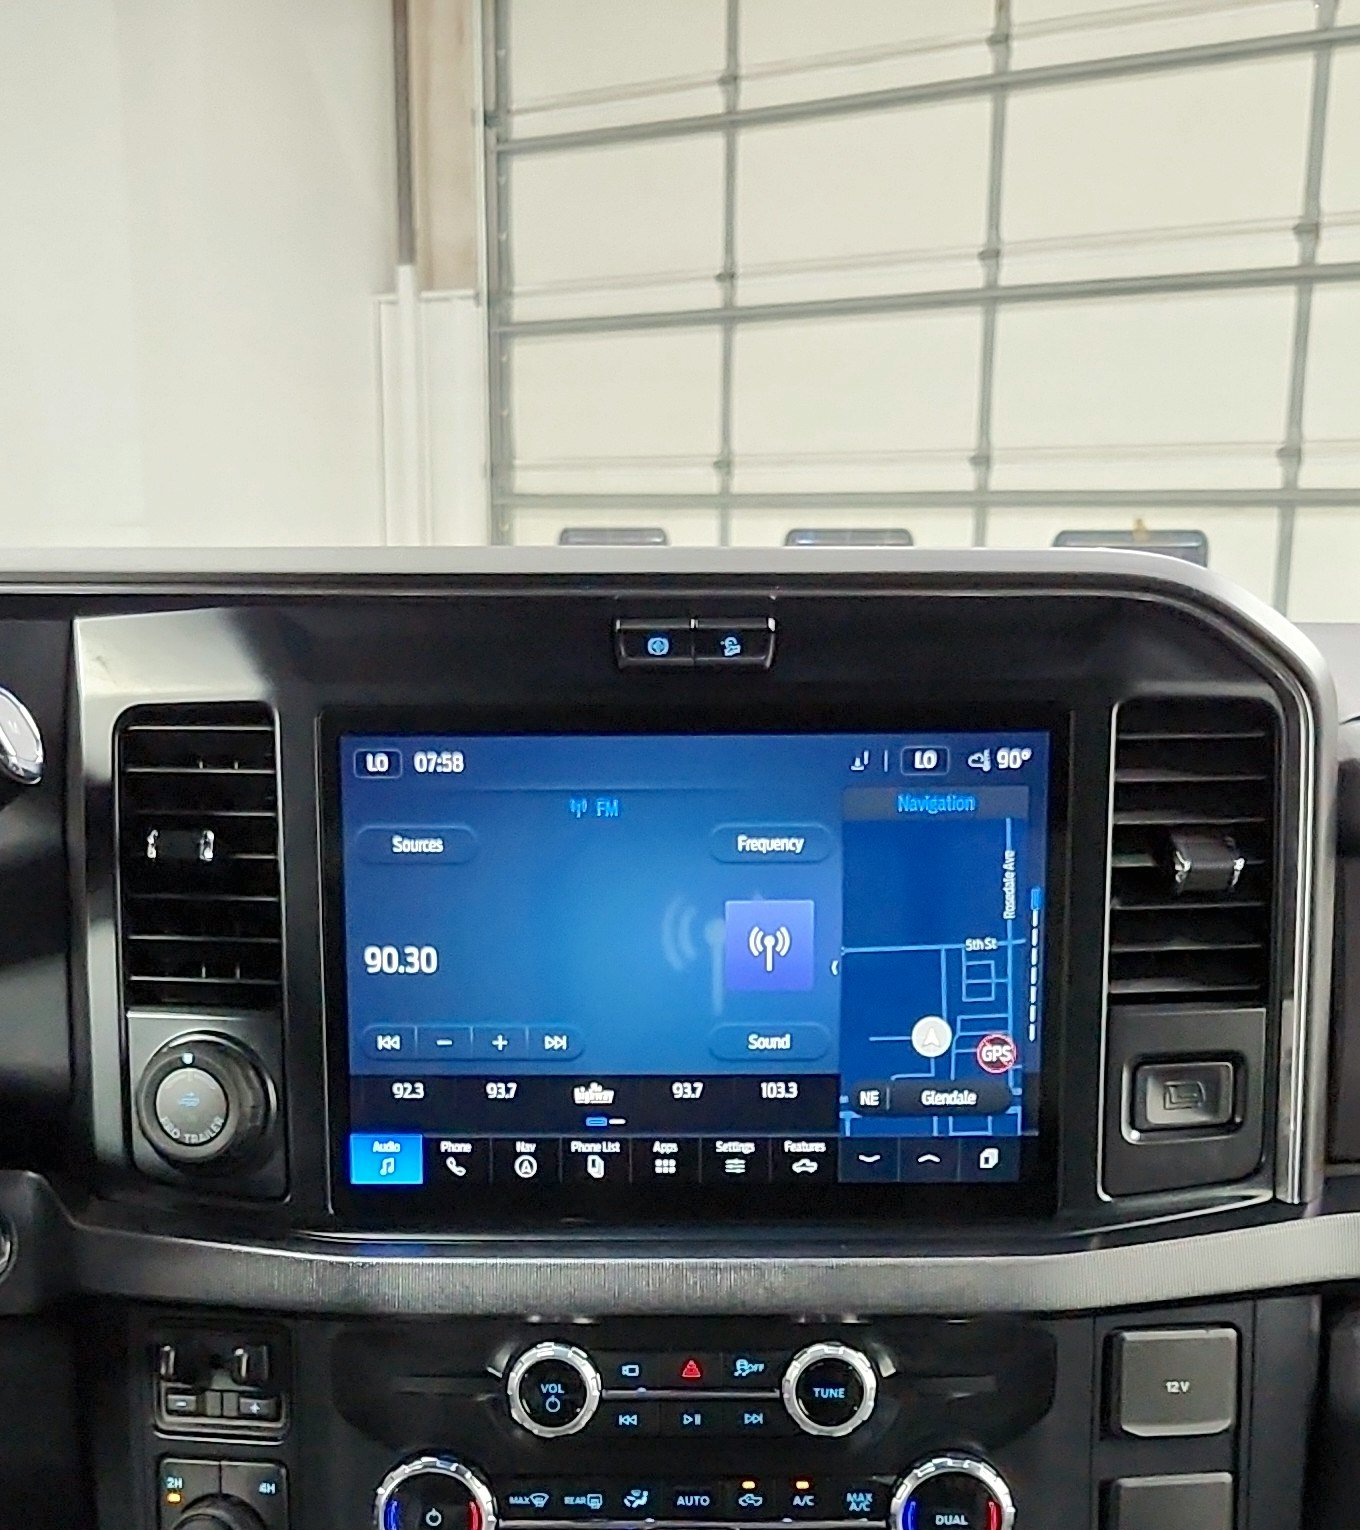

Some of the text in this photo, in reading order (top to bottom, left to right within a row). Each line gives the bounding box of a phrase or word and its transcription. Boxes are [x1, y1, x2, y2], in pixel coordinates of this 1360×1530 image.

[366, 753, 389, 773] LO
[414, 751, 465, 773] 07:58
[914, 750, 938, 770] LO
[996, 747, 1033, 770] 90°
[597, 799, 619, 817] FM
[897, 795, 976, 814] Navigation
[392, 834, 443, 853] Sources
[737, 834, 805, 854] Frequency
[1002, 872, 1016, 919] Rosedale
[965, 938, 983, 952] 5th
[364, 945, 439, 975] 90.30
[747, 1033, 791, 1050] Sound
[981, 1044, 1012, 1062] GPS
[392, 1081, 424, 1099] 92.3
[486, 1081, 517, 1099] 93.7
[671, 1082, 704, 1099] 93.7
[760, 1082, 798, 1099] 103.3
[921, 1089, 978, 1106] Glendale
[859, 1090, 880, 1106] NE
[372, 1140, 401, 1153] Audio
[440, 1140, 472, 1153] Phone
[515, 1140, 537, 1153] Nav
[570, 1140, 621, 1153] Phone List
[652, 1140, 678, 1154] Apps
[715, 1140, 756, 1155] Settings
[783, 1140, 827, 1153] Features
[540, 1383, 565, 1394] VOL
[812, 1387, 846, 1399] TUNE
[166, 1477, 183, 1489] 2H
[258, 1482, 276, 1495] 4H
[509, 1496, 531, 1505] MAX
[564, 1496, 587, 1505] REAR
[676, 1495, 711, 1507] AUTO
[792, 1495, 815, 1507] A/C
[846, 1492, 873, 1502] MAX
[848, 1501, 871, 1512] A/C
[935, 1514, 969, 1527] DUAL
